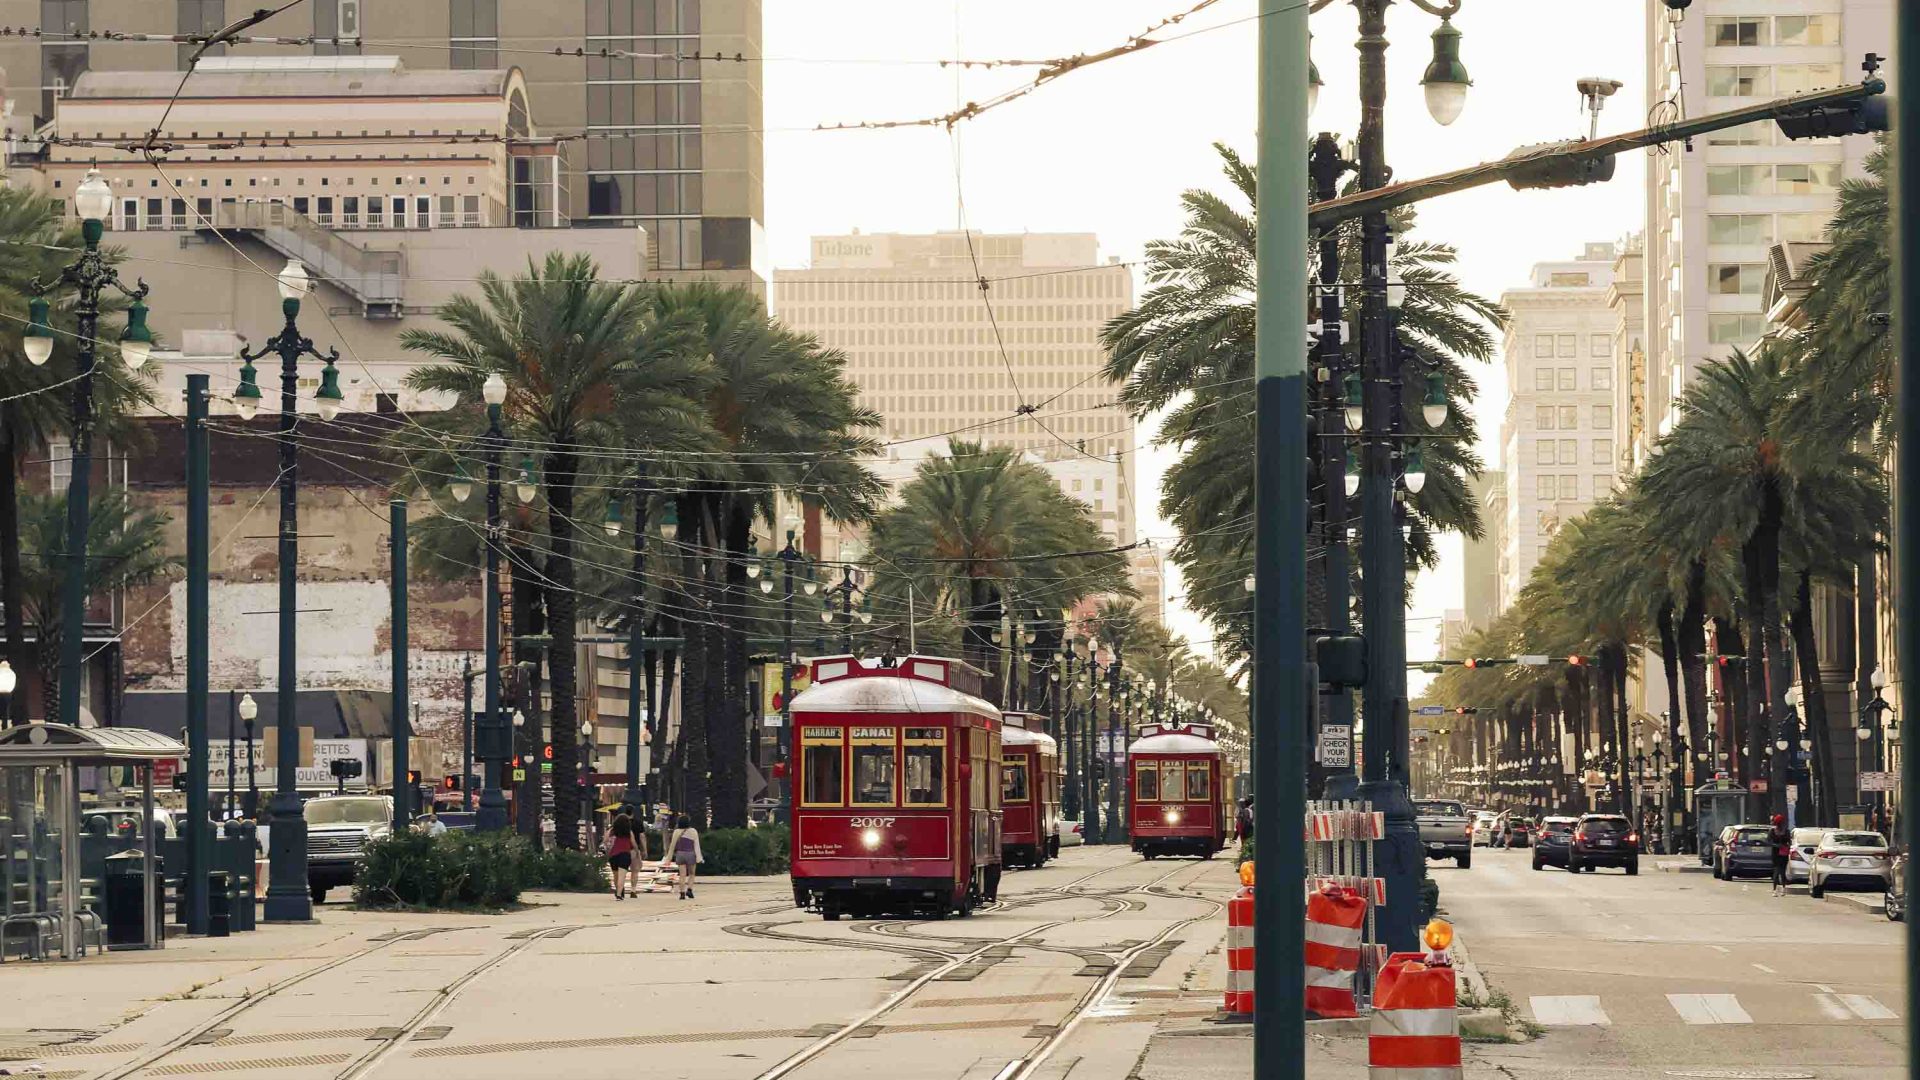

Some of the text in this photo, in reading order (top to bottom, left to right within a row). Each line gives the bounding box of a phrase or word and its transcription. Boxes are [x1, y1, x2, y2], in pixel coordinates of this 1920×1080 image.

[817, 239, 873, 256] Tulane
[852, 728, 893, 737] CANAL
[1324, 740, 1348, 748] CHECK
[1326, 748, 1346, 756] YOUR
[850, 817, 896, 828] 2007
